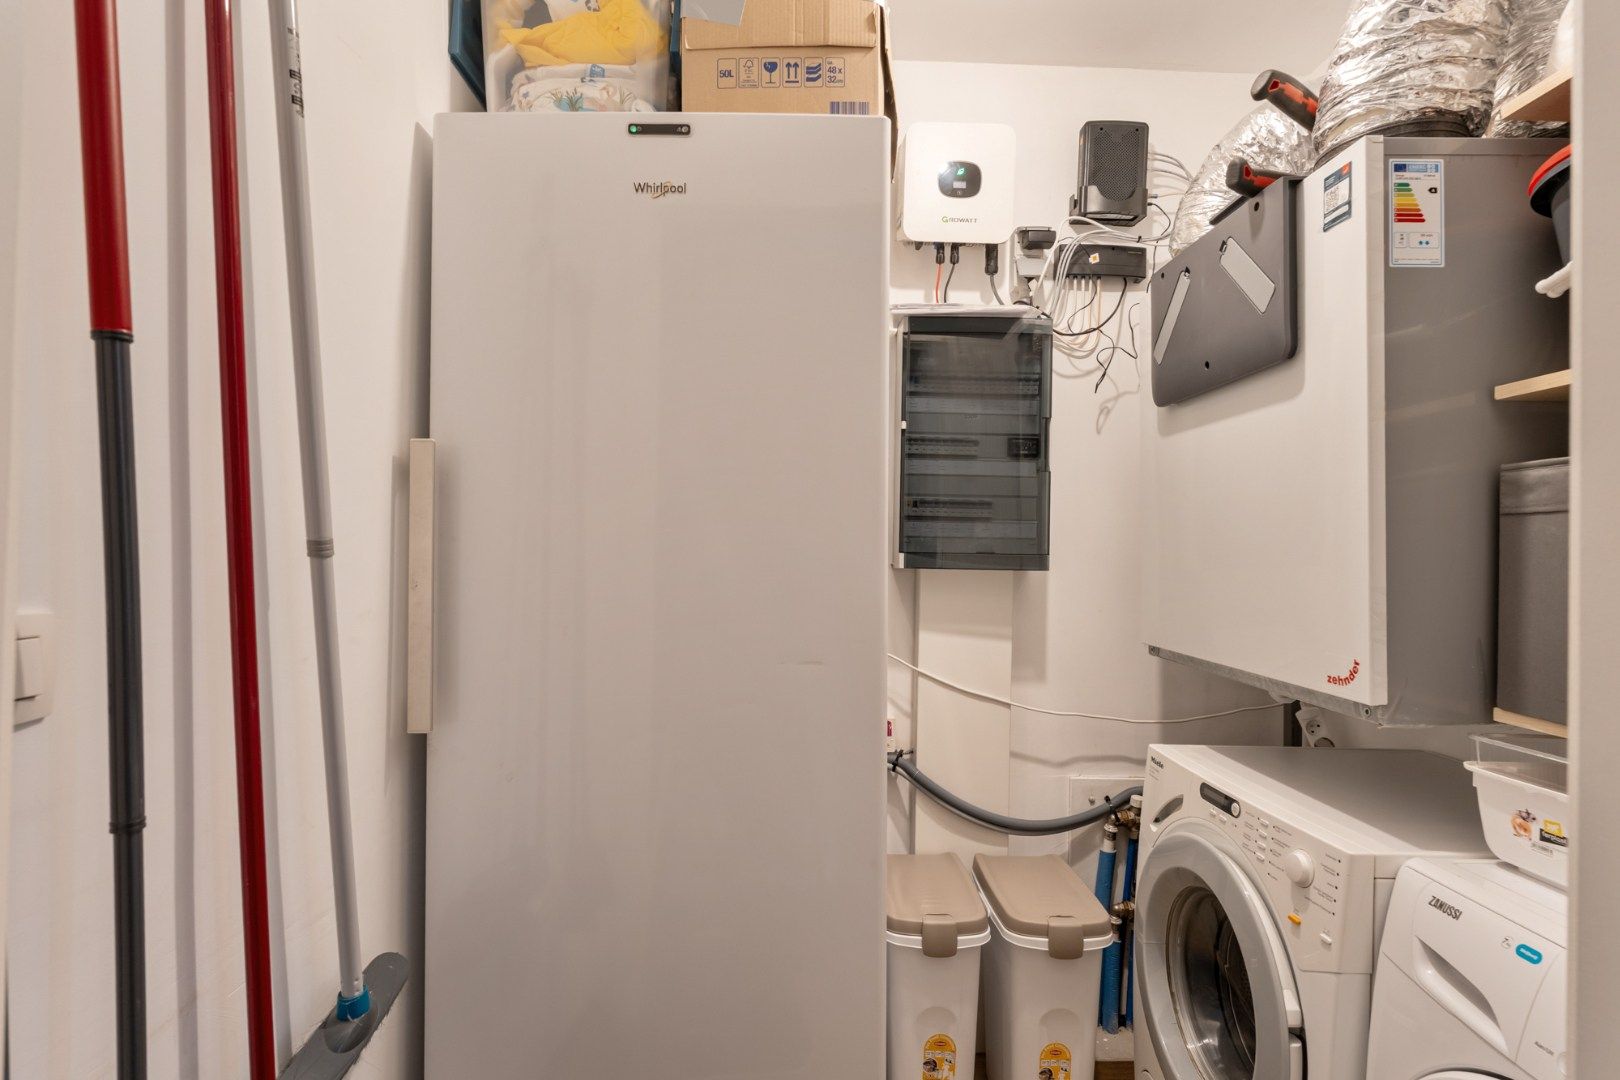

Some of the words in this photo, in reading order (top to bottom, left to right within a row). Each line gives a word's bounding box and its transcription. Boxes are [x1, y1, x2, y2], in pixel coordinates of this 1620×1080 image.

[719, 69, 735, 78] 50L
[827, 66, 837, 74] 48
[633, 181, 687, 197] Whirlpool
[1327, 659, 1360, 686] zehnder
[1428, 895, 1463, 920] ZANUSSI
